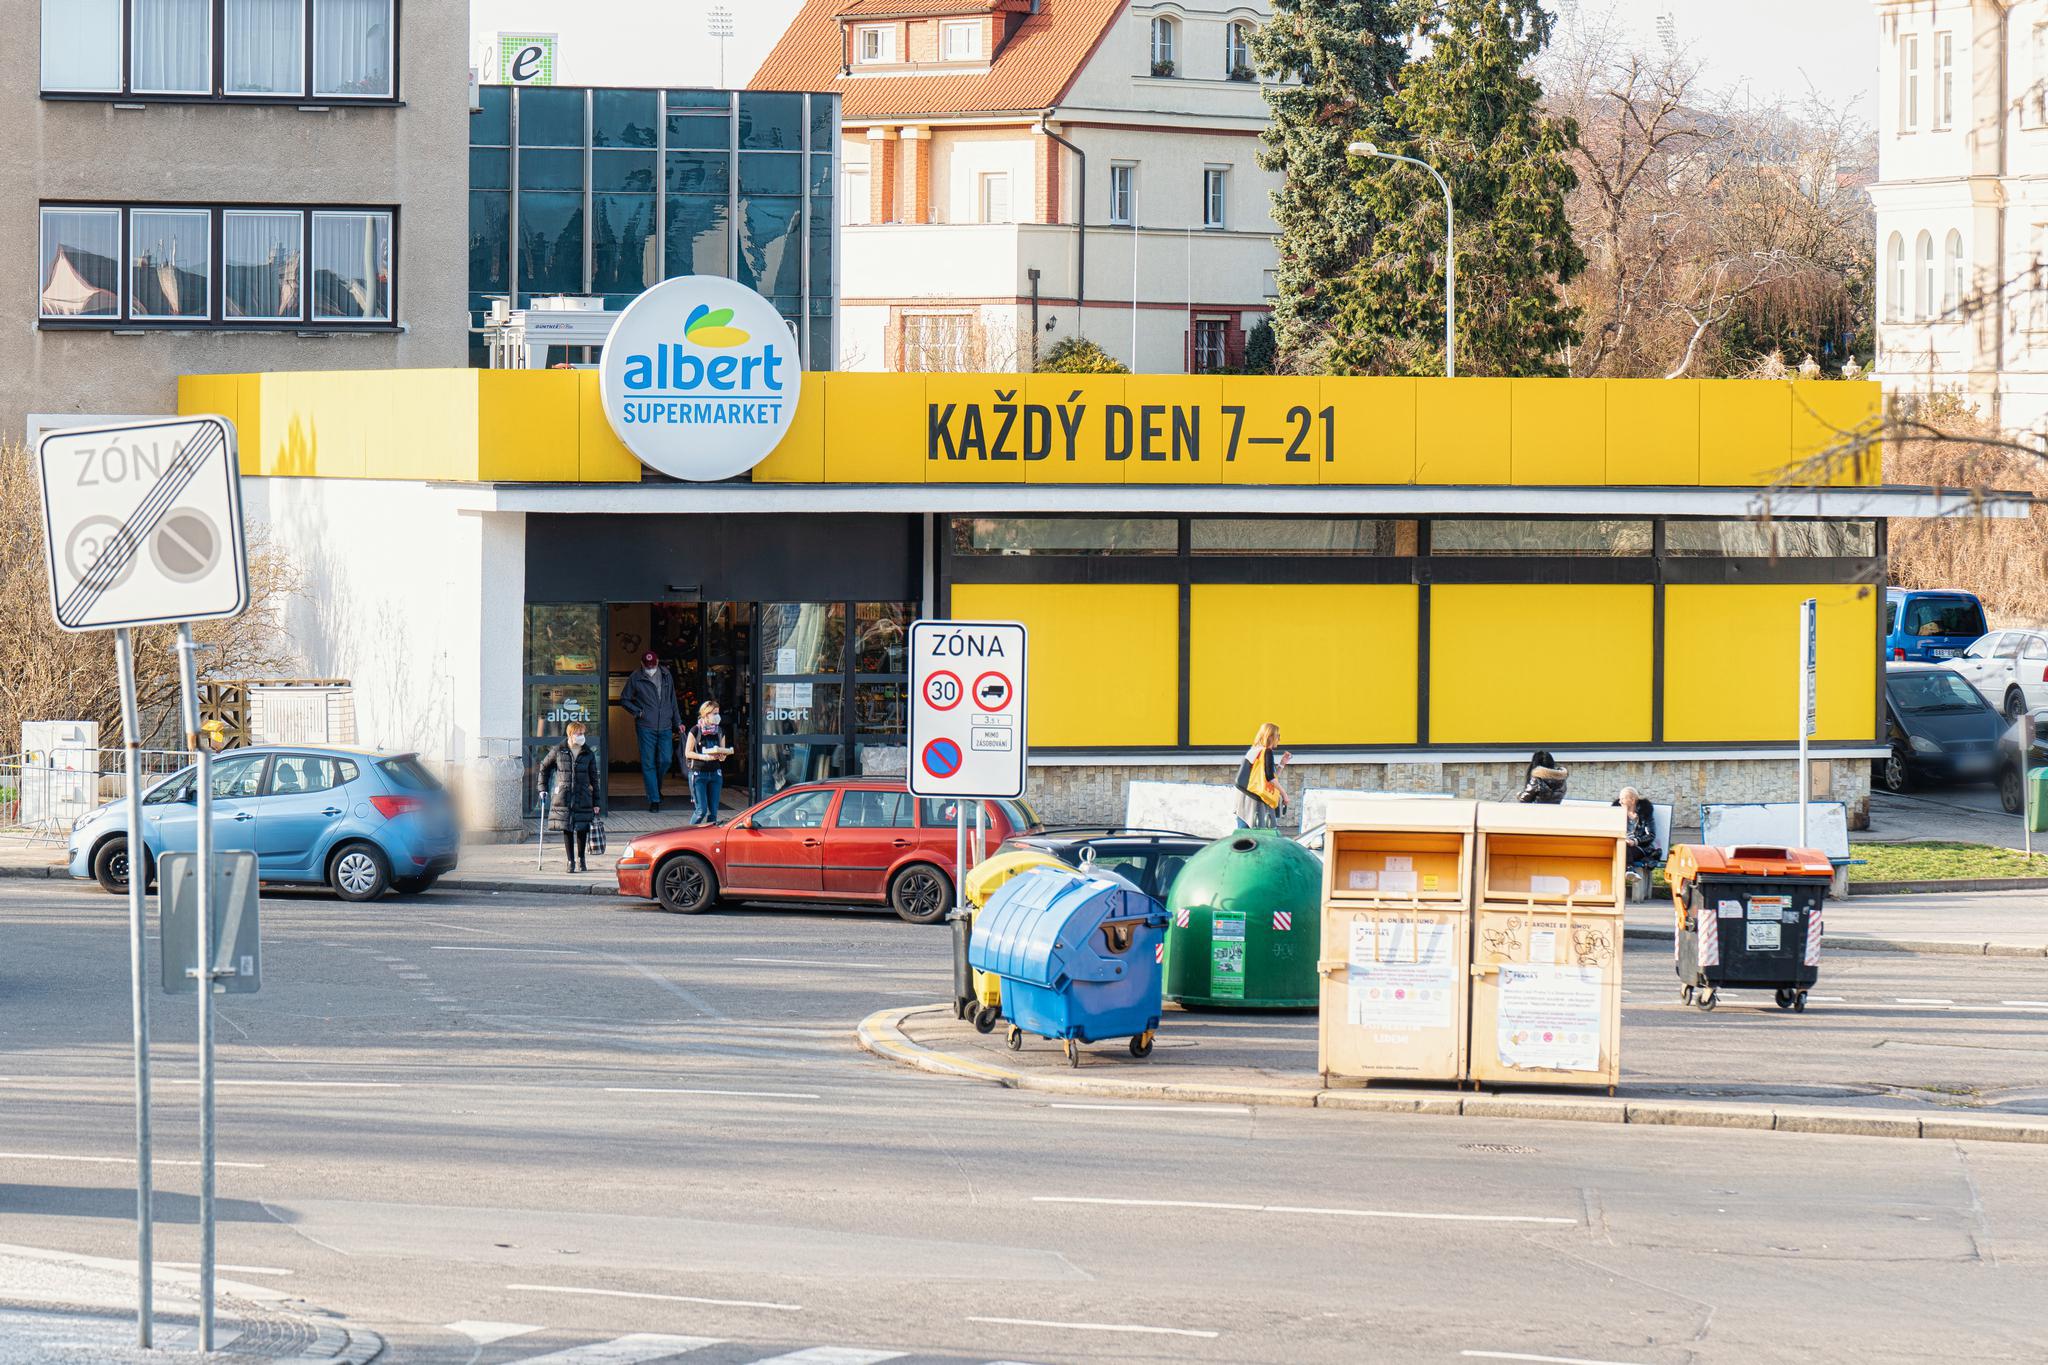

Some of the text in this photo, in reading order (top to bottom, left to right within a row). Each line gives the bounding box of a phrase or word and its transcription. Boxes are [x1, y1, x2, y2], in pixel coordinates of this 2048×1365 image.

[623, 343, 783, 391] albert
[623, 402, 782, 424] SUPERMARKET
[927, 389, 1086, 461] KAŽDÝ
[1105, 404, 1200, 462] DEN
[74, 436, 194, 487] ZÓNA
[931, 629, 1005, 658] ZÓNA
[931, 681, 955, 701] 30
[547, 708, 591, 722] albert
[766, 707, 809, 721] albert
